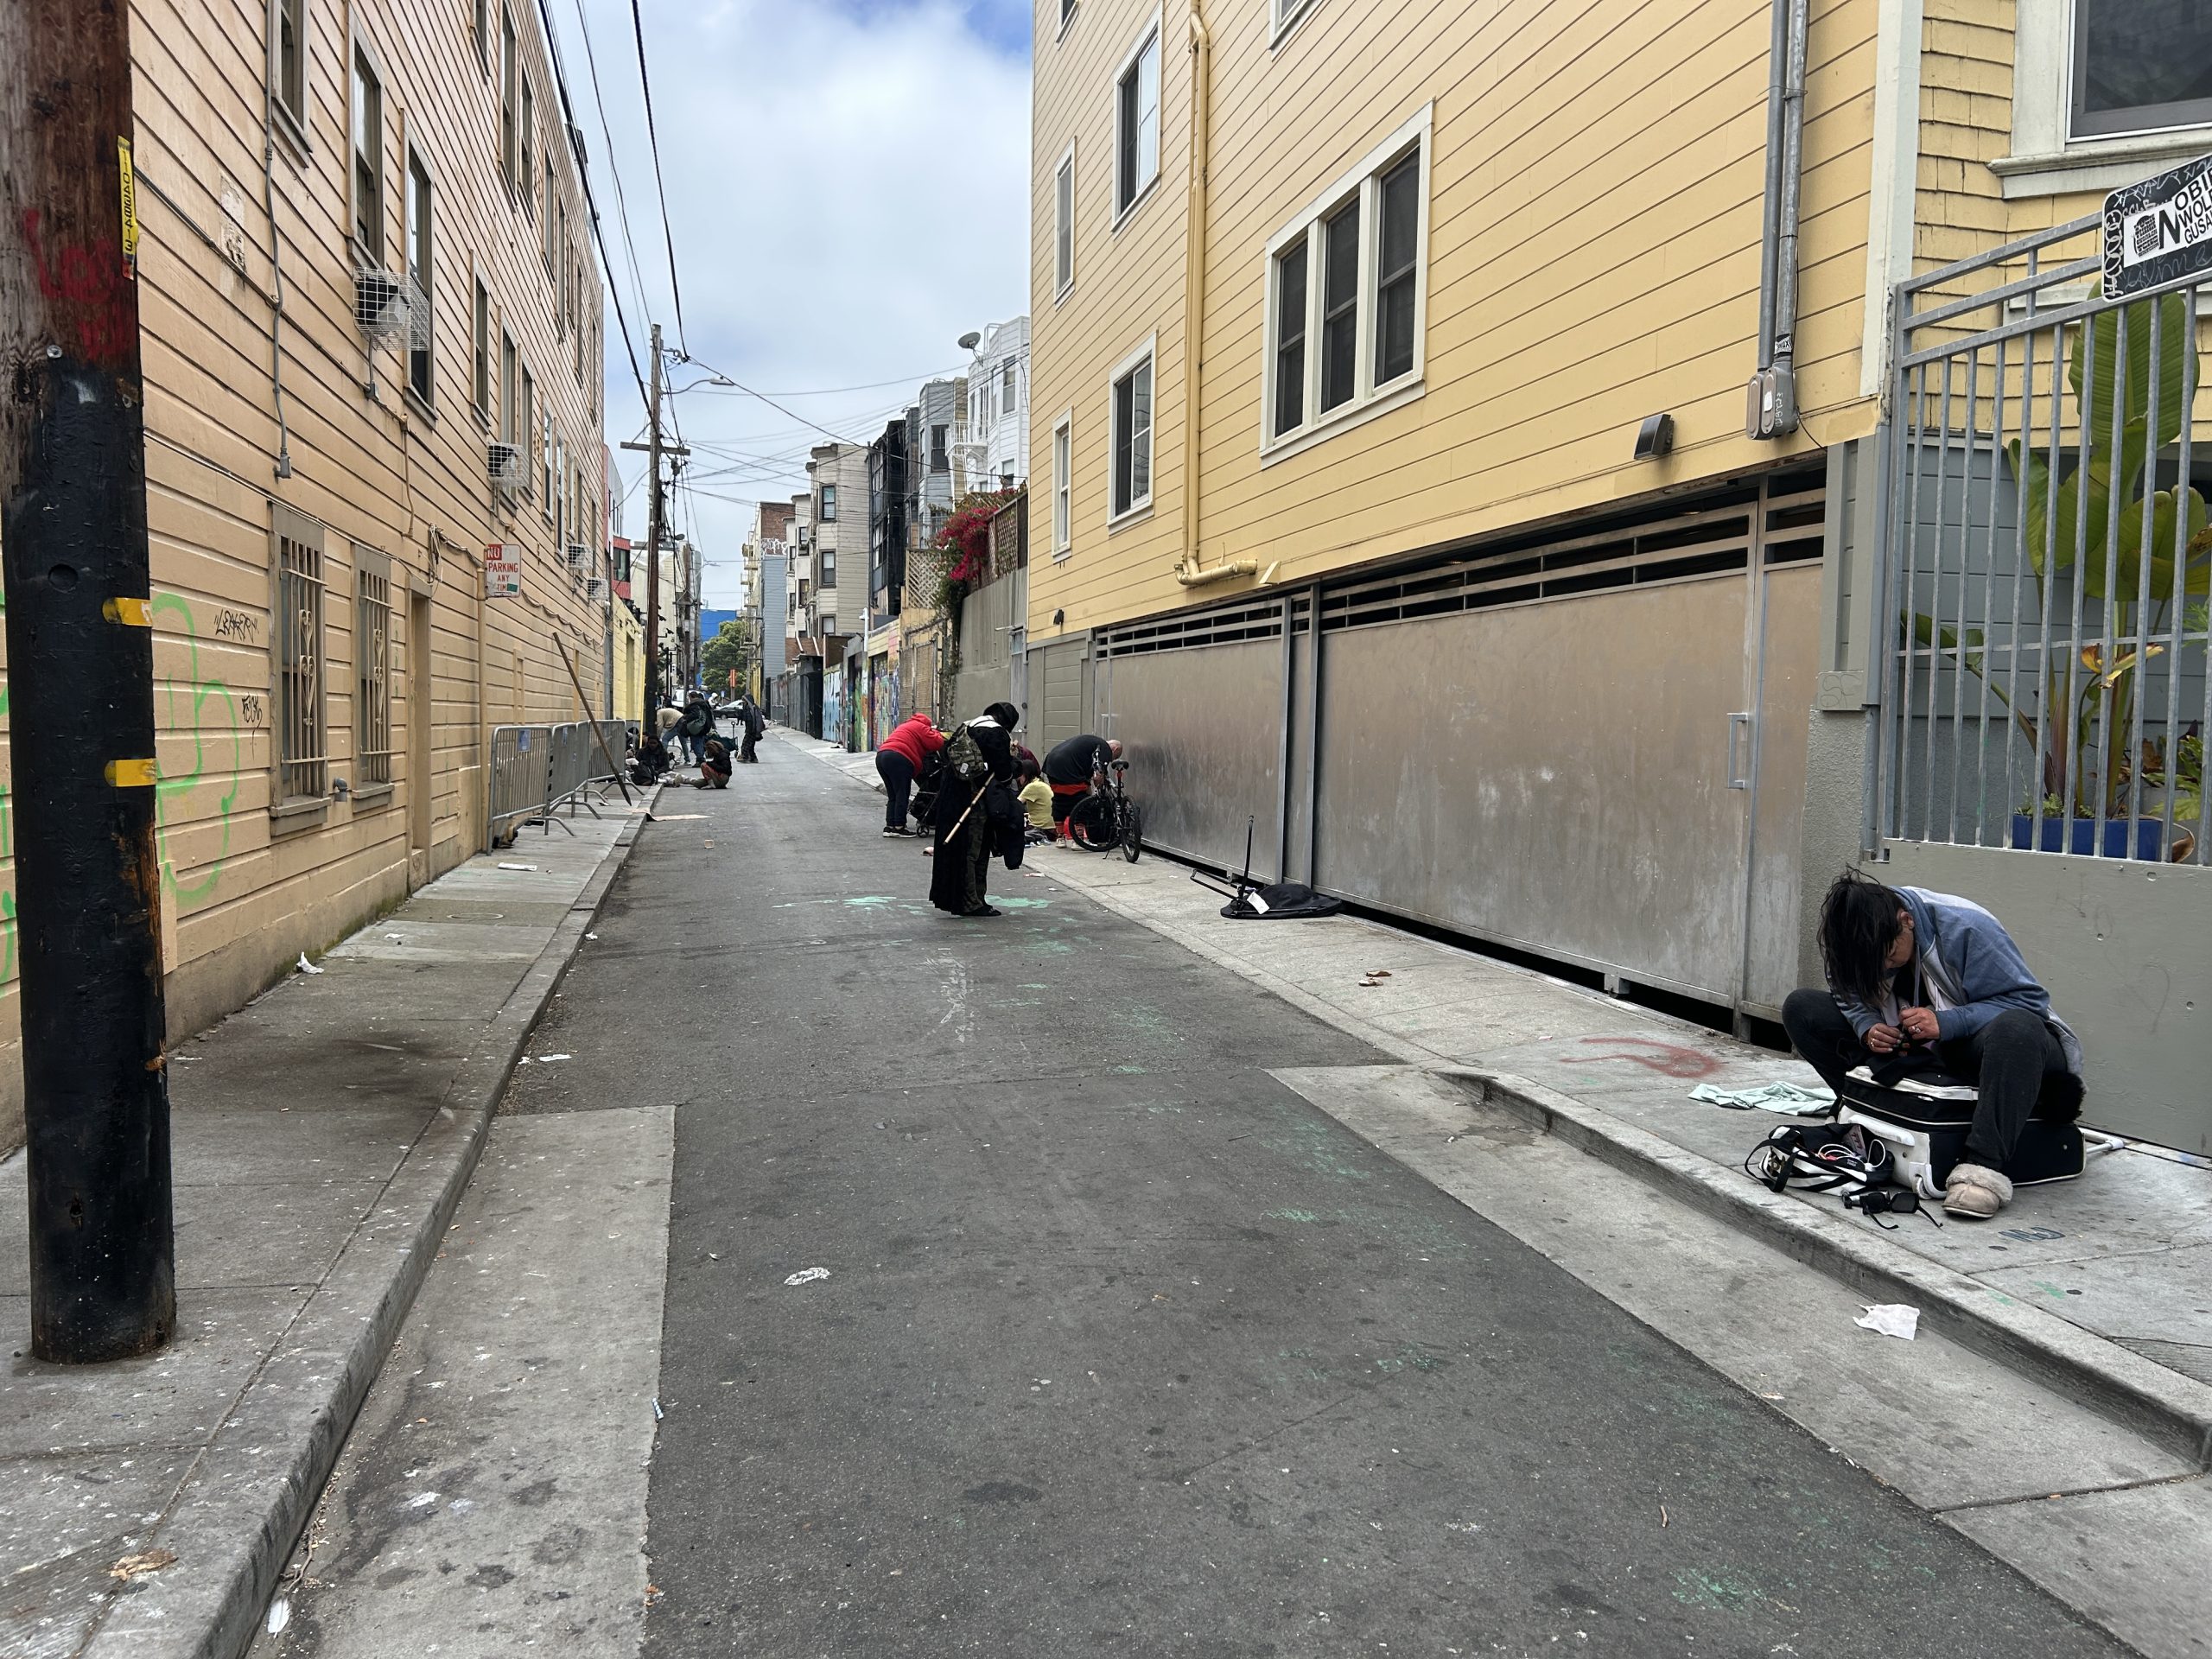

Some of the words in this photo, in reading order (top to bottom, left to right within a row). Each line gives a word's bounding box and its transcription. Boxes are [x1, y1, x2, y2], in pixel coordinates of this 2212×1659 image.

[487, 547, 500, 559] NO
[488, 563, 518, 573] PARKING
[497, 583, 511, 592] TIM
